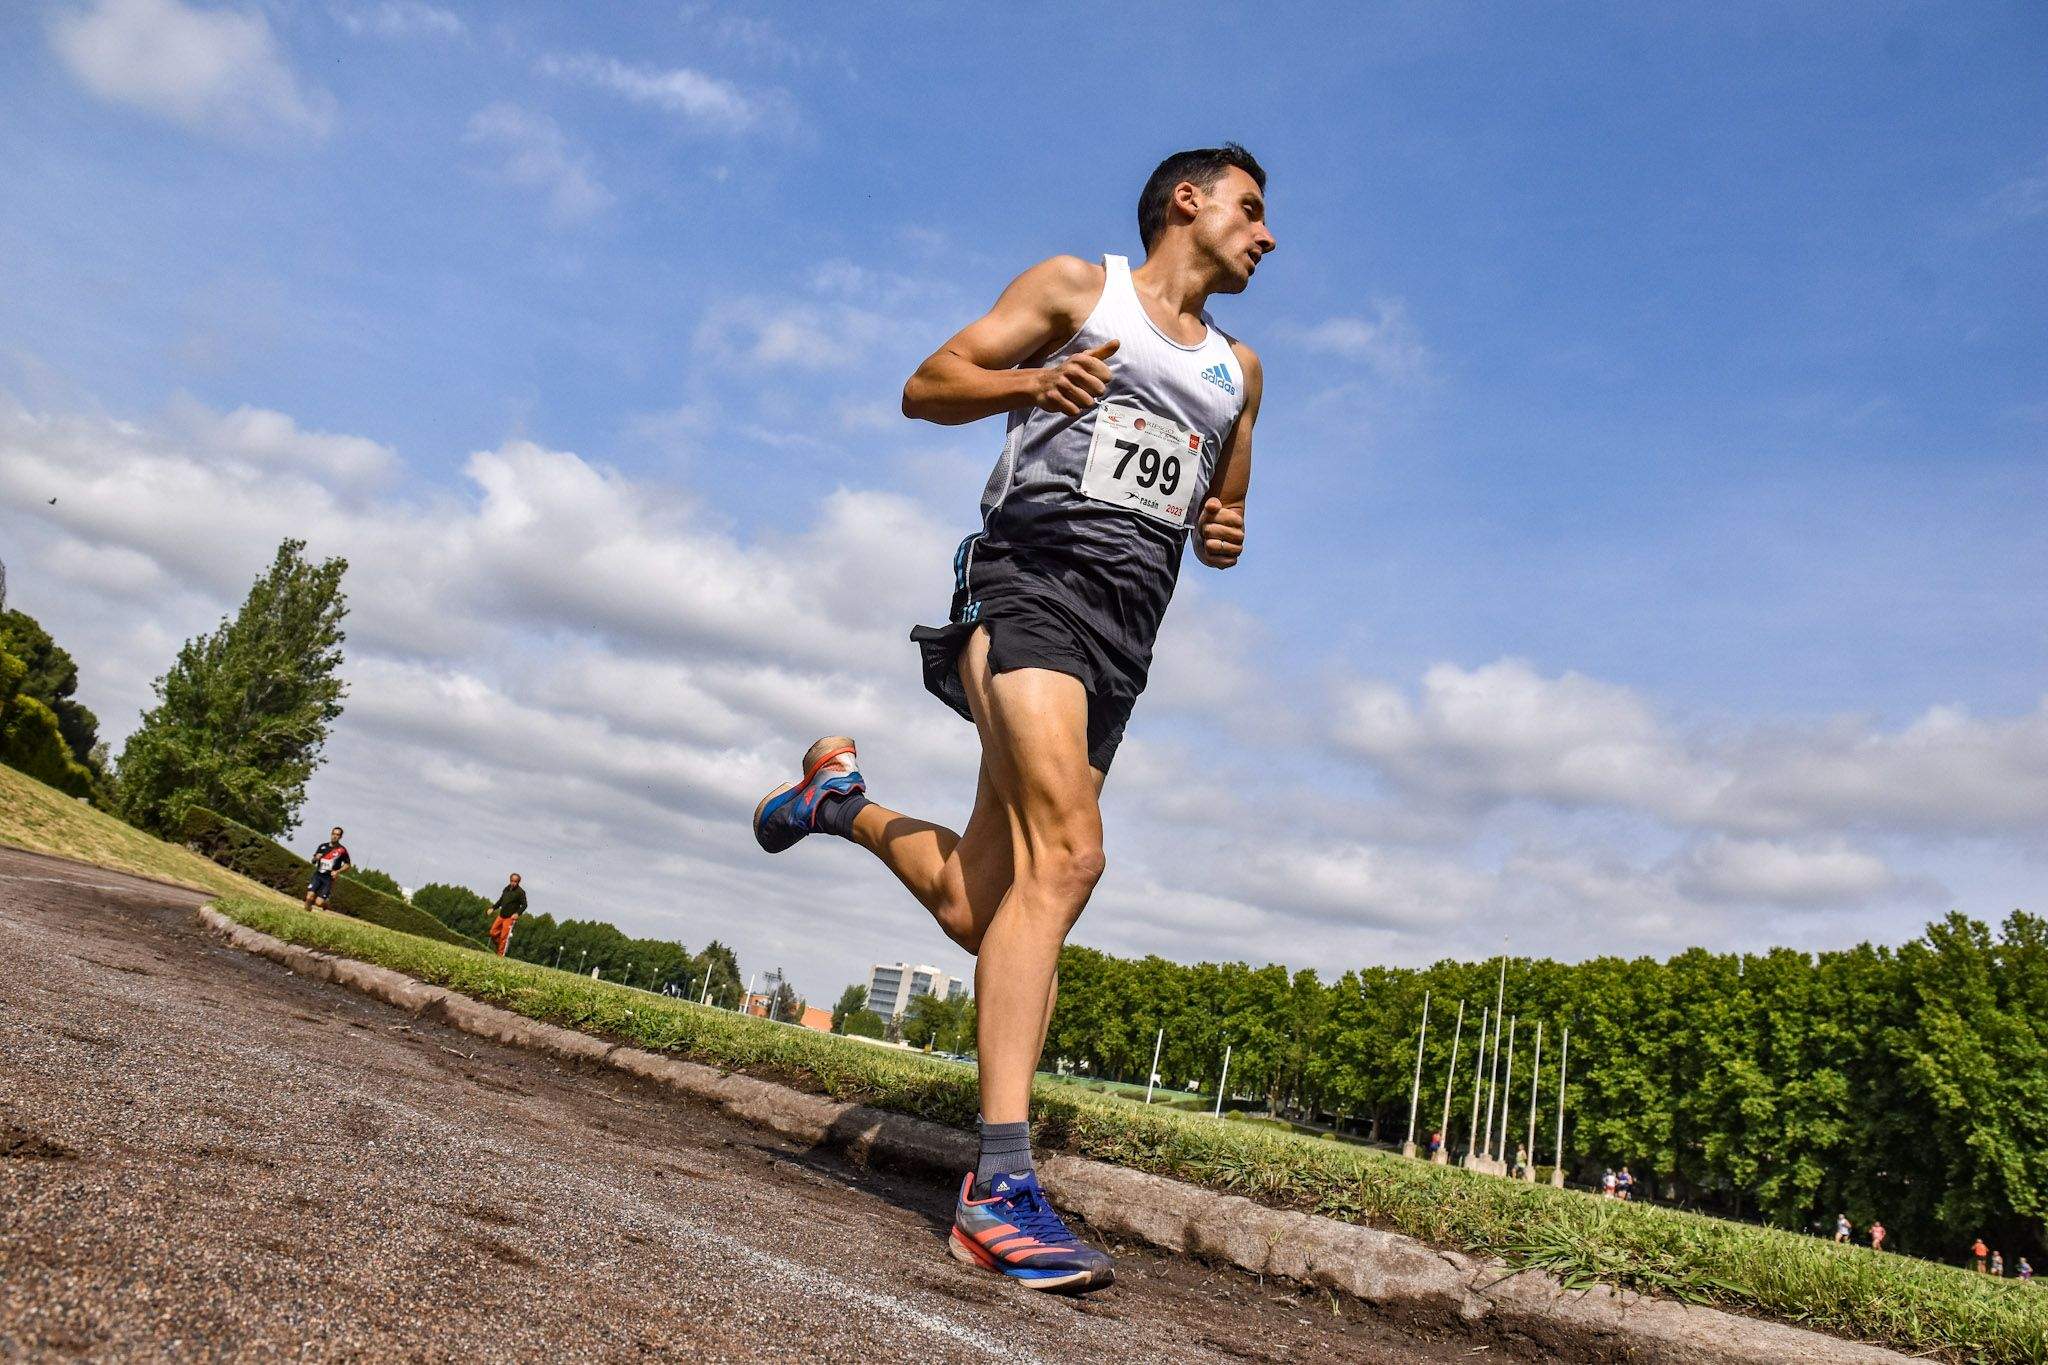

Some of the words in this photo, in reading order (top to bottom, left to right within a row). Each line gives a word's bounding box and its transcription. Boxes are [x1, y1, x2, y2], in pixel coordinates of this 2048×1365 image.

[1201, 371, 1236, 396] adidas
[1112, 438, 1181, 496] 799
[1165, 504, 1183, 517] 2023
